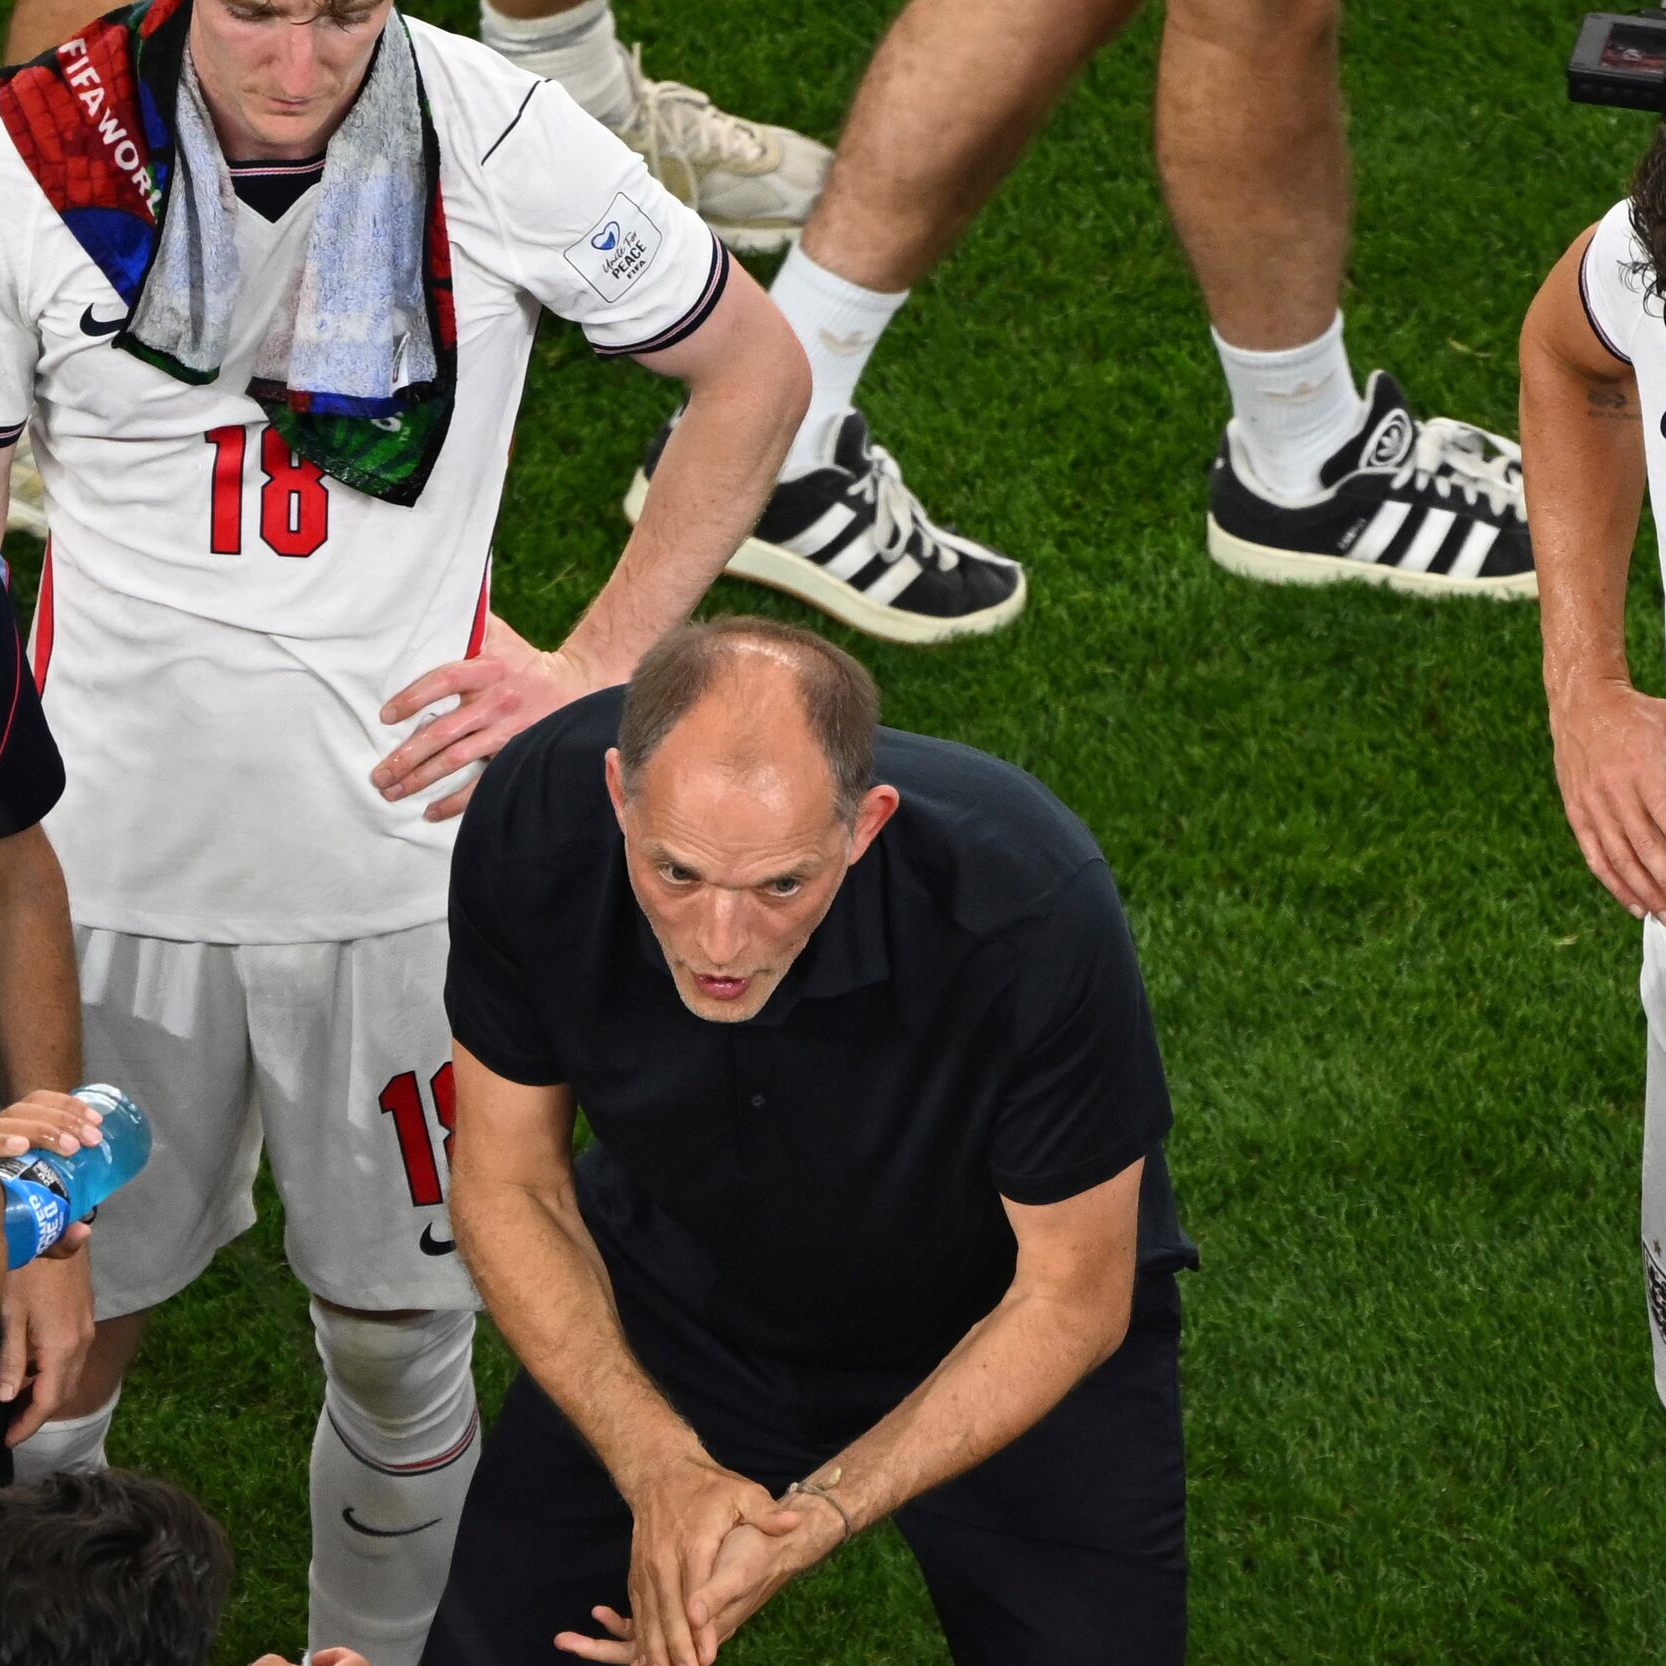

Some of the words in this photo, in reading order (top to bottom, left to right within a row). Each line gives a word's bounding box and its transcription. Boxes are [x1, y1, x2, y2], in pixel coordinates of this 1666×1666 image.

[57, 37, 105, 118] FIFA
[611, 239, 647, 280] PEACE
[626, 260, 646, 280] FIFA
[205, 424, 329, 558] 18
[379, 1060, 457, 1208] 1
